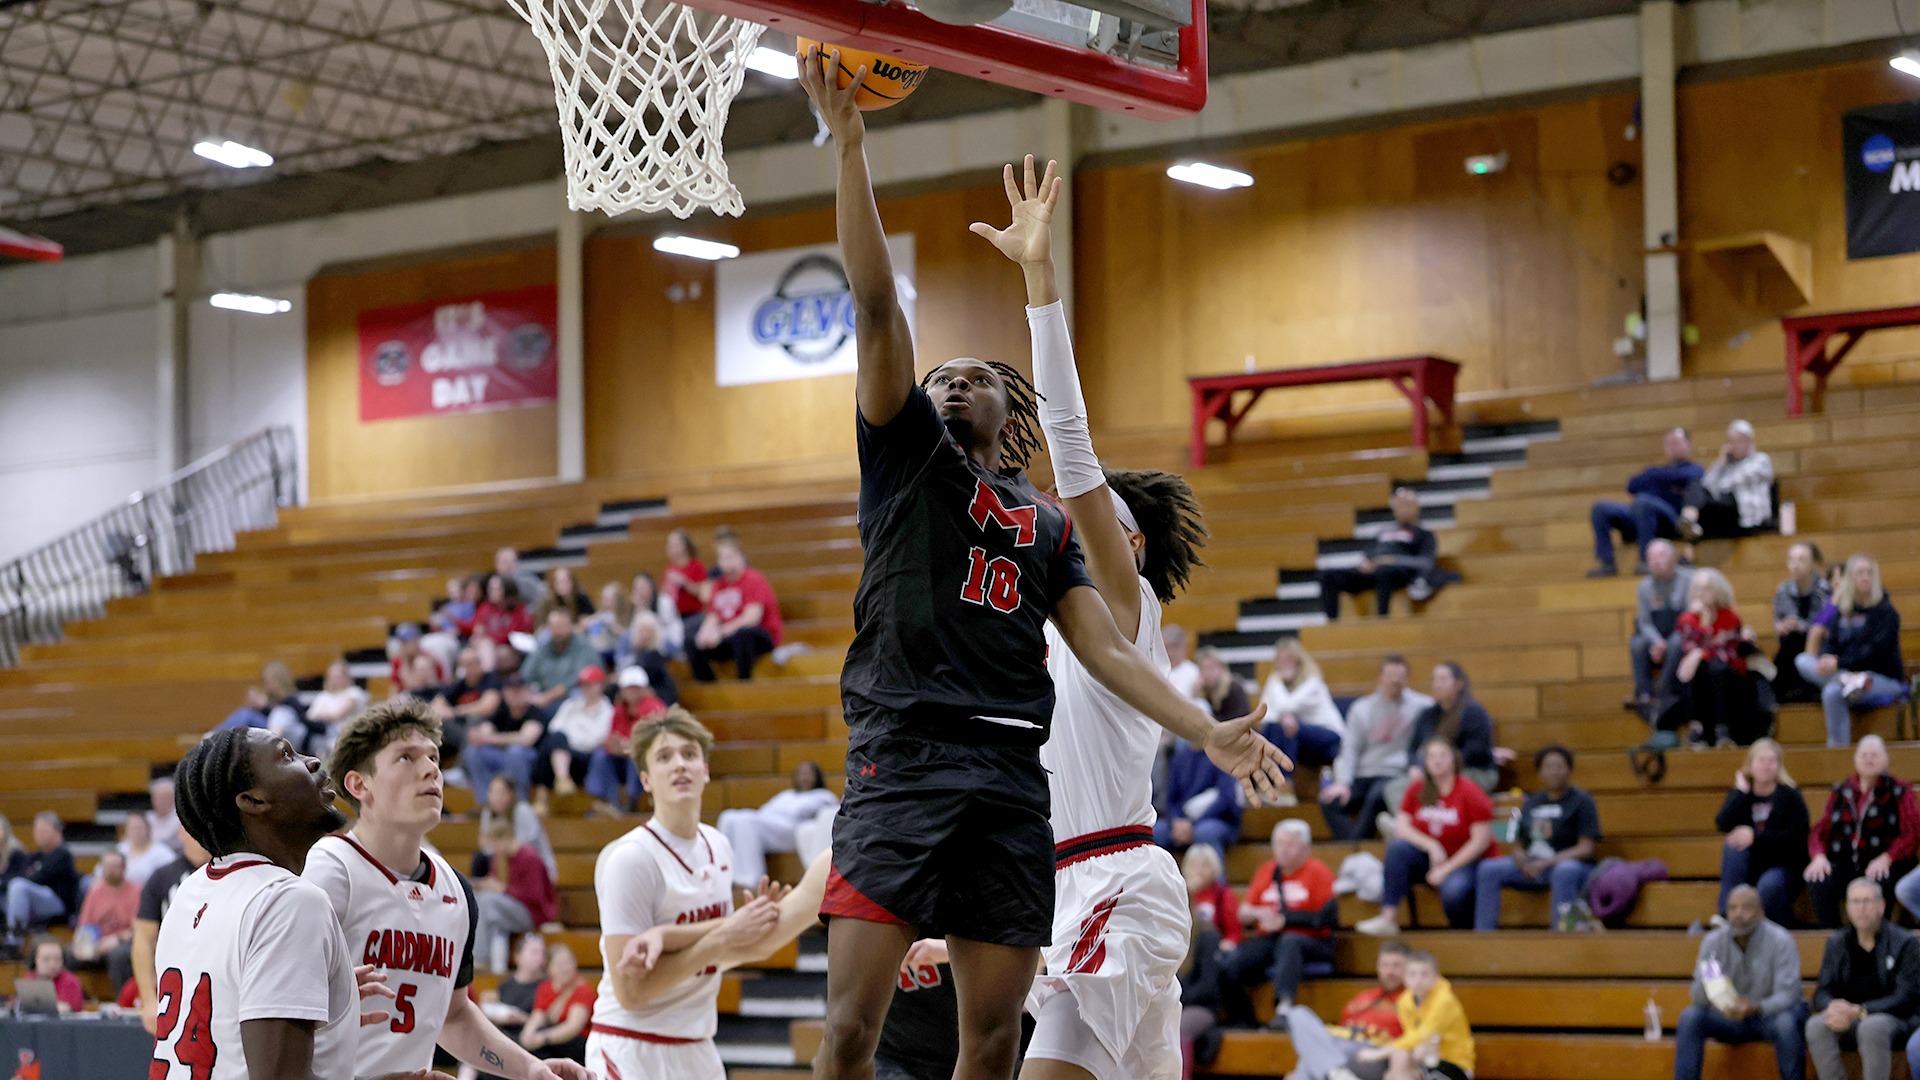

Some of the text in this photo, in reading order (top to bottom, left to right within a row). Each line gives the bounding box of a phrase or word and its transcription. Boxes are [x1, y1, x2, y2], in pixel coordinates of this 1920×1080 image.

[872, 59, 928, 91] ilson
[420, 335, 499, 374] GAME
[431, 374, 489, 408] DAY
[960, 545, 1022, 614] 10
[362, 929, 455, 979] CARDINALS
[147, 967, 218, 1080] 24
[390, 983, 418, 1034] 5
